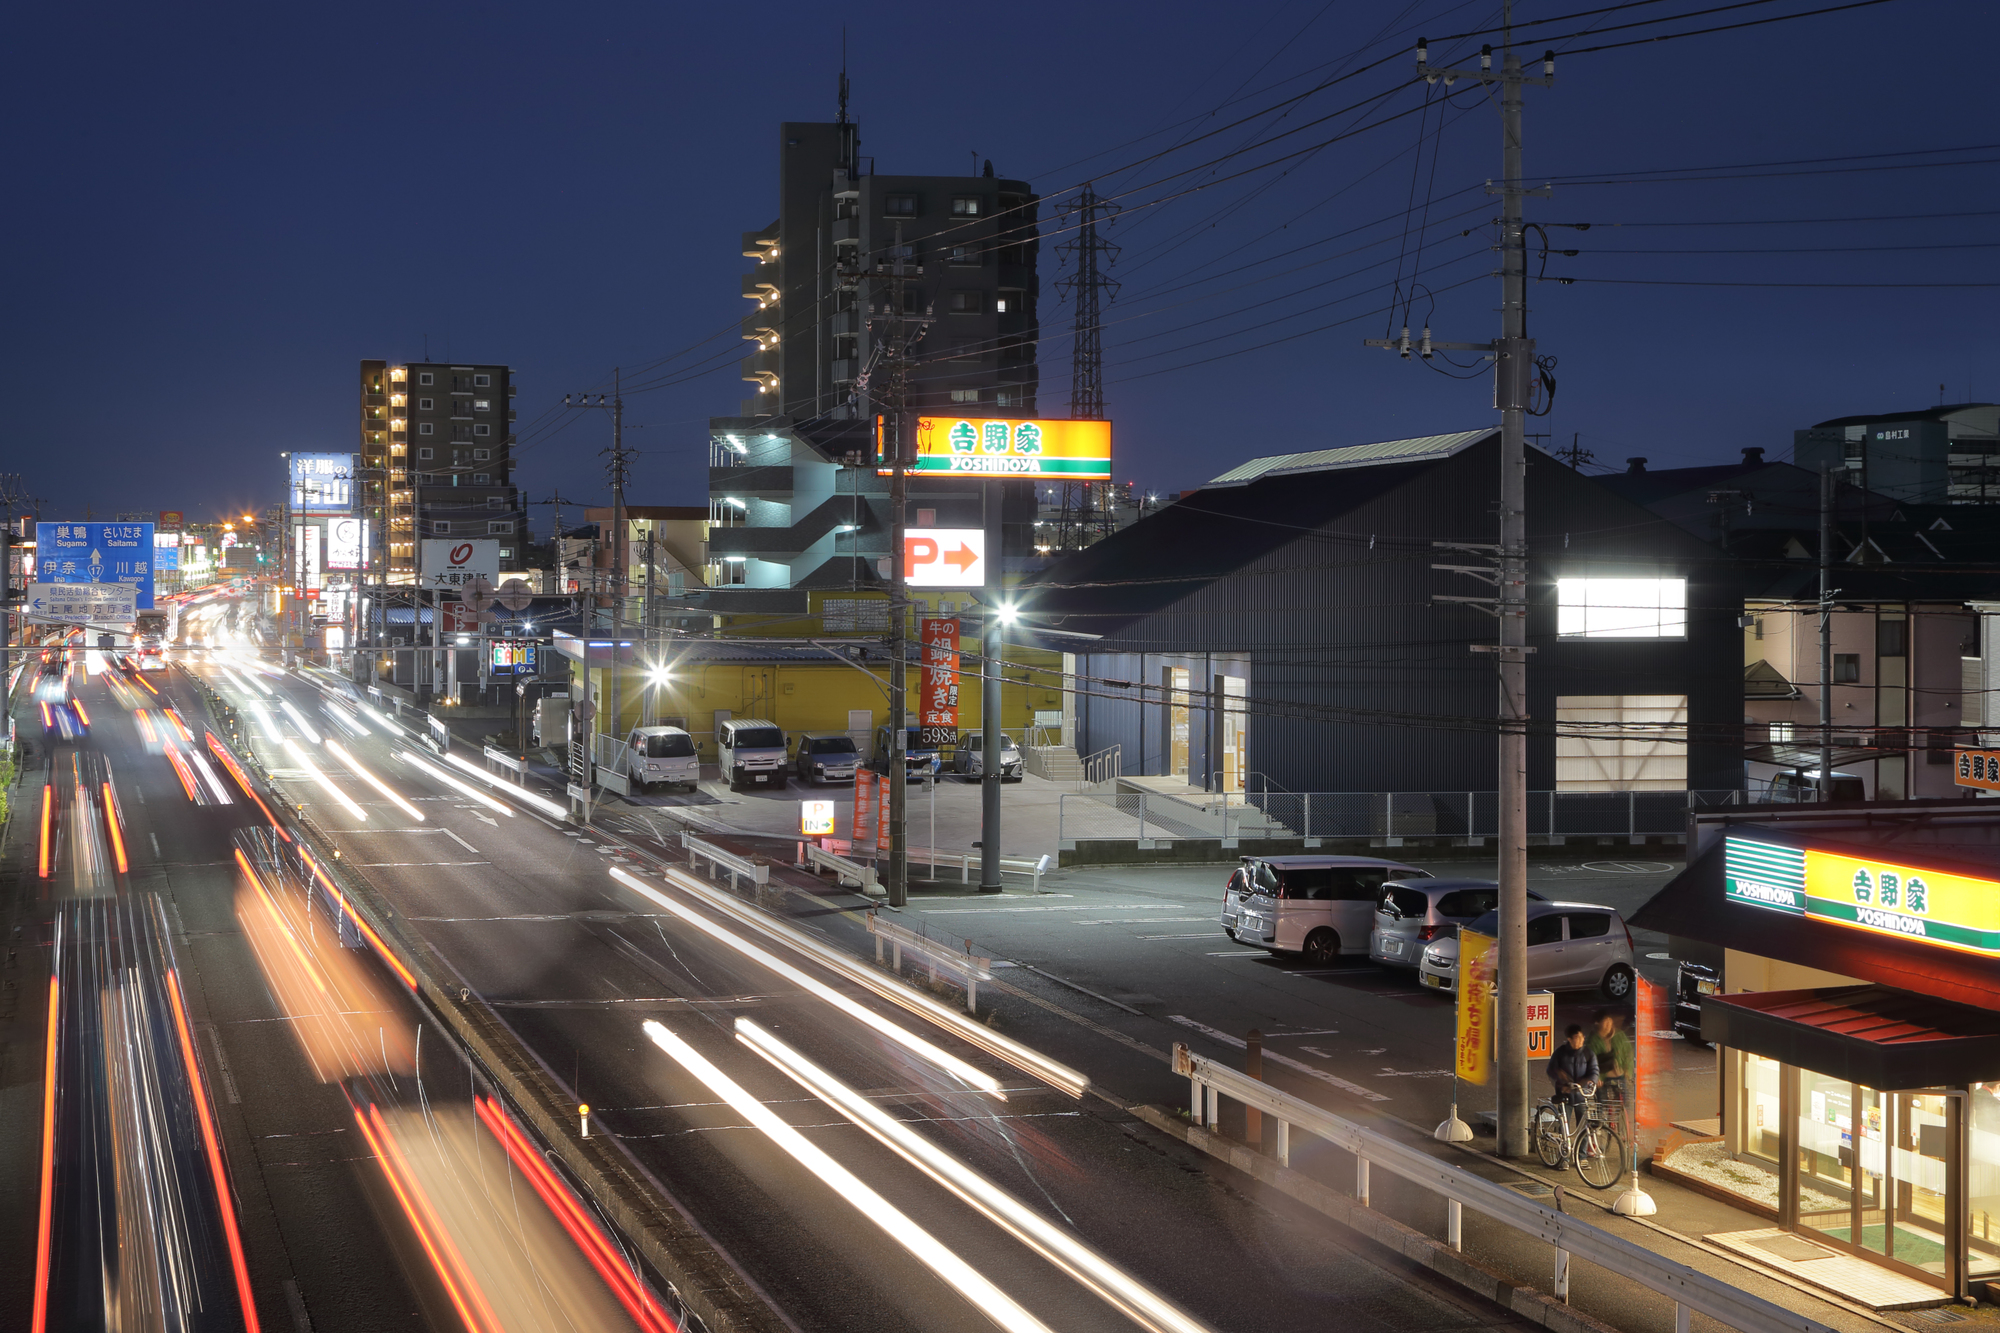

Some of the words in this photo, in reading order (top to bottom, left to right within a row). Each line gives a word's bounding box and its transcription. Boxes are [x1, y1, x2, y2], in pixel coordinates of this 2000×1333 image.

[949, 420, 1042, 455] 吉野家
[296, 459, 347, 475] 洋服の
[949, 457, 1041, 471] YOSHINOYA
[294, 478, 348, 504] 青山
[56, 526, 87, 539] 巣鴨
[103, 526, 142, 539] さいたま
[56, 540, 87, 548] Sugamo
[904, 537, 939, 577] P
[43, 561, 76, 574] 伊奈
[90, 566, 101, 575] 17
[115, 561, 147, 574] 川越
[49, 604, 132, 614] 上尾地方庁舎
[929, 621, 954, 635] 牛の
[493, 646, 536, 665] GAME
[948, 685, 957, 706] 限定
[926, 709, 953, 724] 定食
[813, 803, 824, 815] P
[804, 820, 818, 830] IN
[1735, 880, 1797, 906] YOSHINOYA
[1853, 867, 1929, 915] 吉野家
[1856, 907, 1927, 936] YOSHINOYA
[1528, 1030, 1549, 1051] UT
